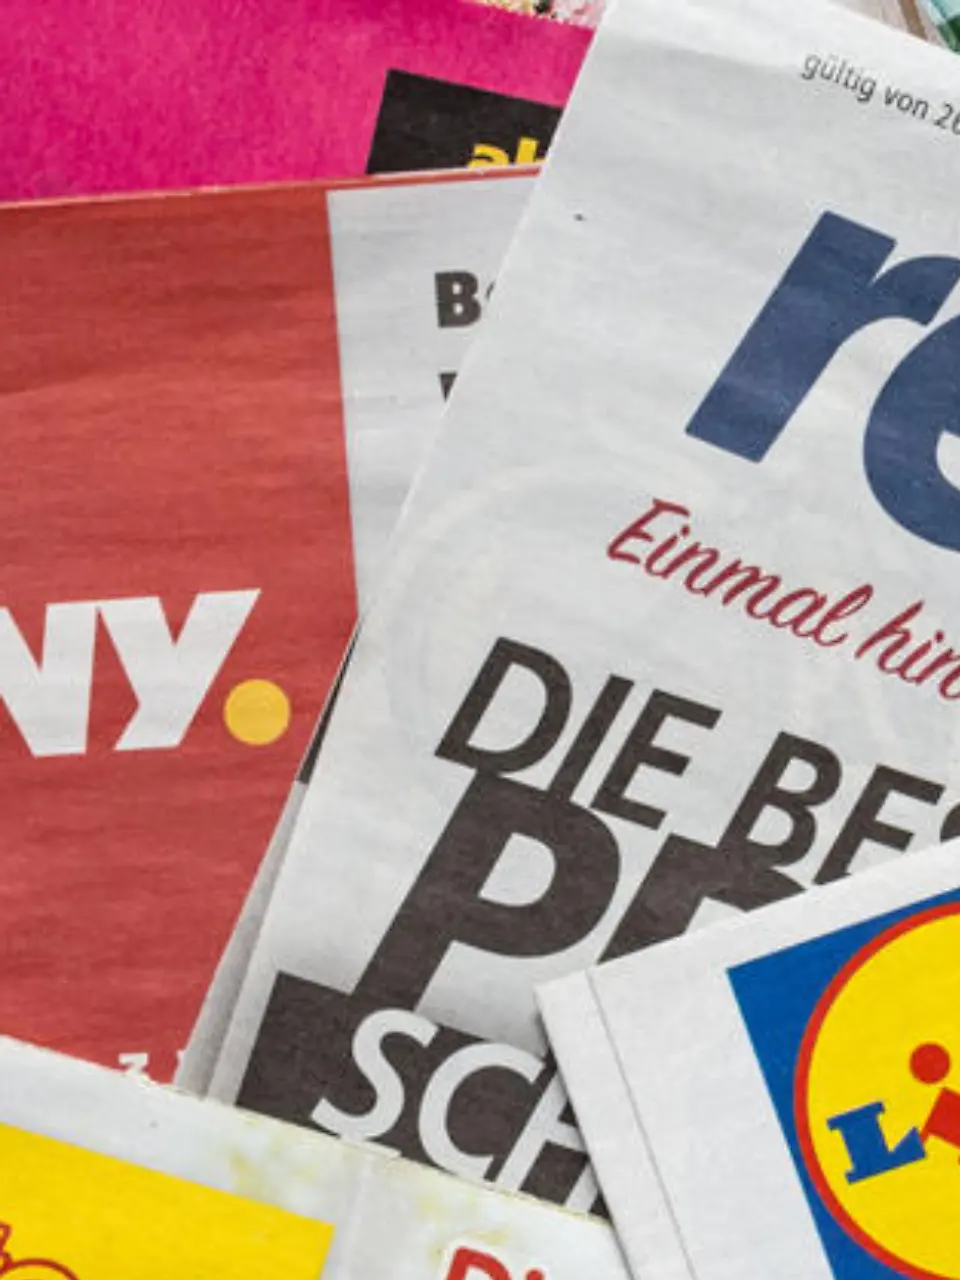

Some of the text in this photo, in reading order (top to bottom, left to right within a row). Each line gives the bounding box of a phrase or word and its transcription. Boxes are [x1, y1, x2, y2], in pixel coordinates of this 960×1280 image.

[801, 52, 877, 101] gültig
[884, 88, 930, 119] von
[605, 498, 874, 647] Einmal
[434, 636, 722, 830] DIE
